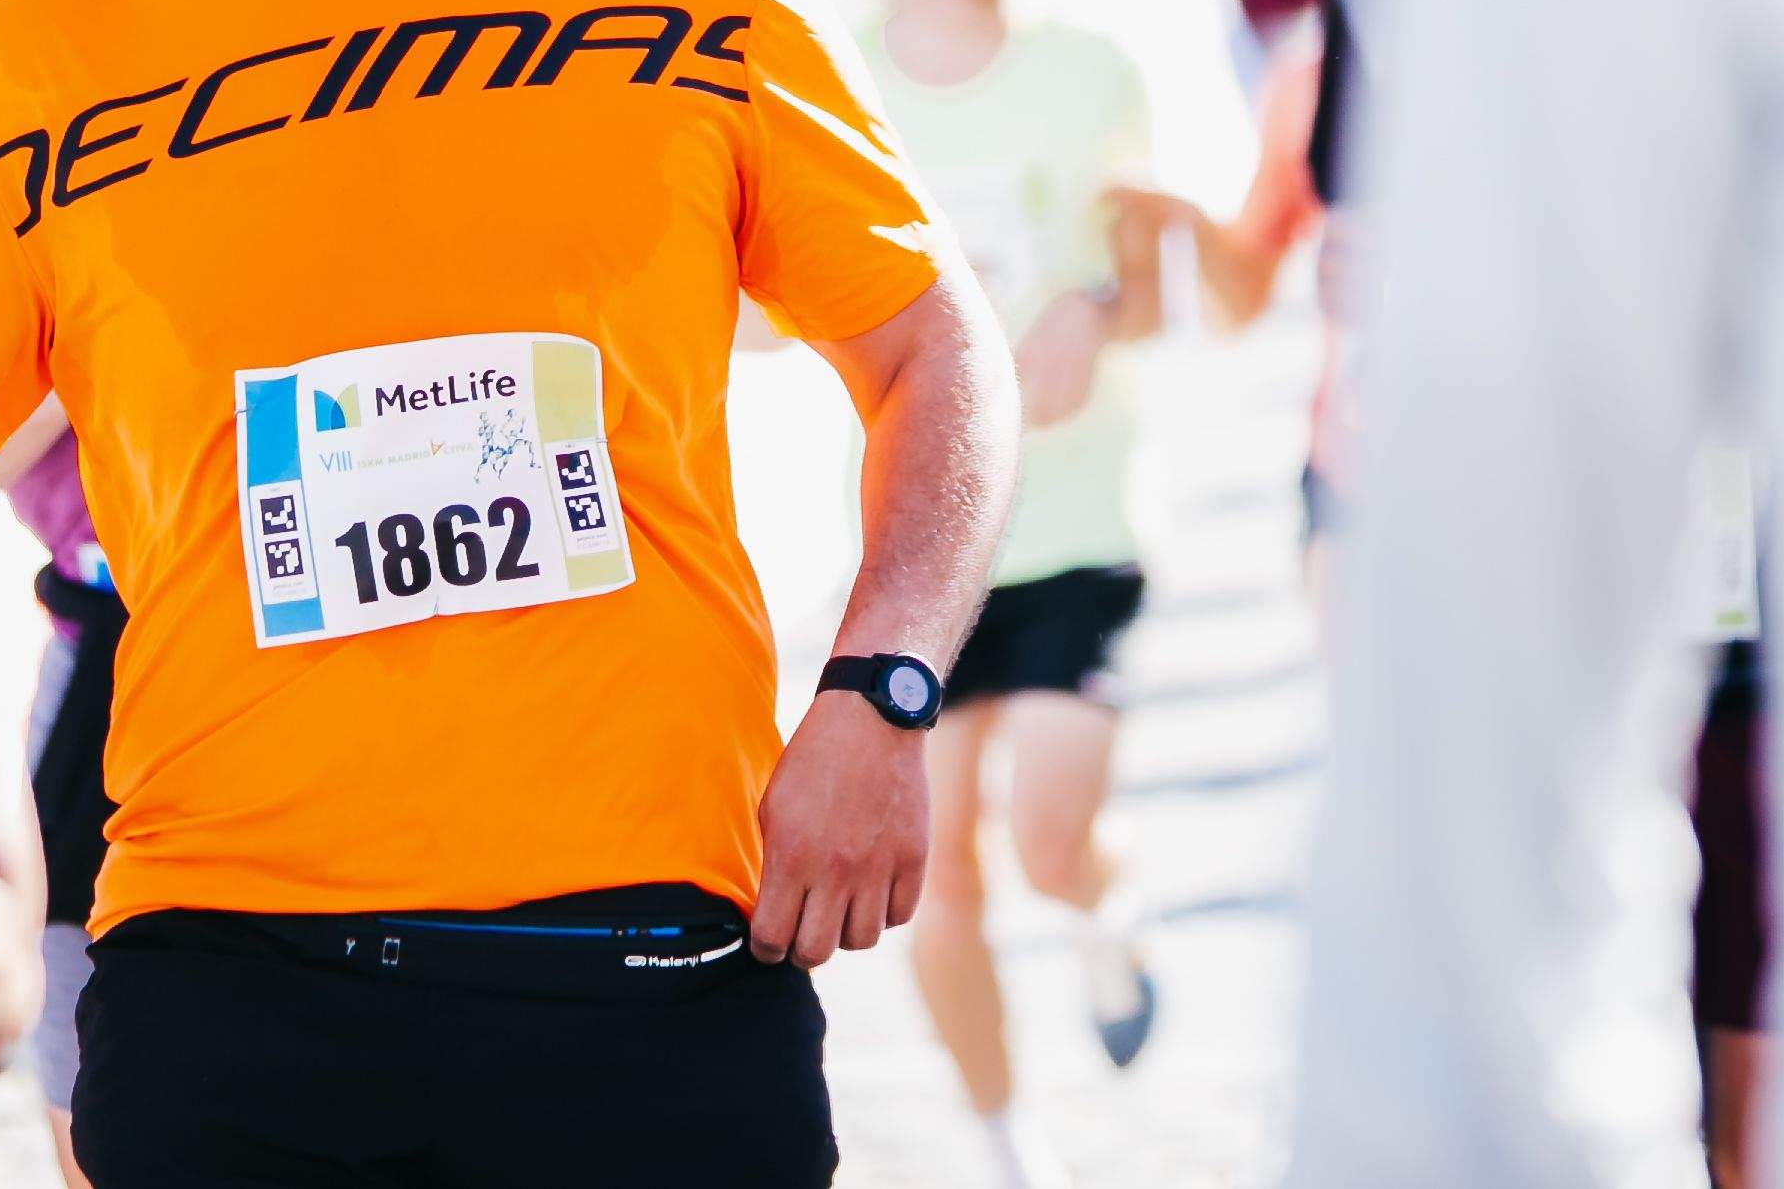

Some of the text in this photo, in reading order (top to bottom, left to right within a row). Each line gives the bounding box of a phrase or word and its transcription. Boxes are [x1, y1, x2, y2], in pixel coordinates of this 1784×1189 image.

[375, 369, 517, 417] MetLife
[319, 450, 353, 473] VIII
[387, 449, 430, 464] MADRID
[335, 496, 541, 605] 1862
